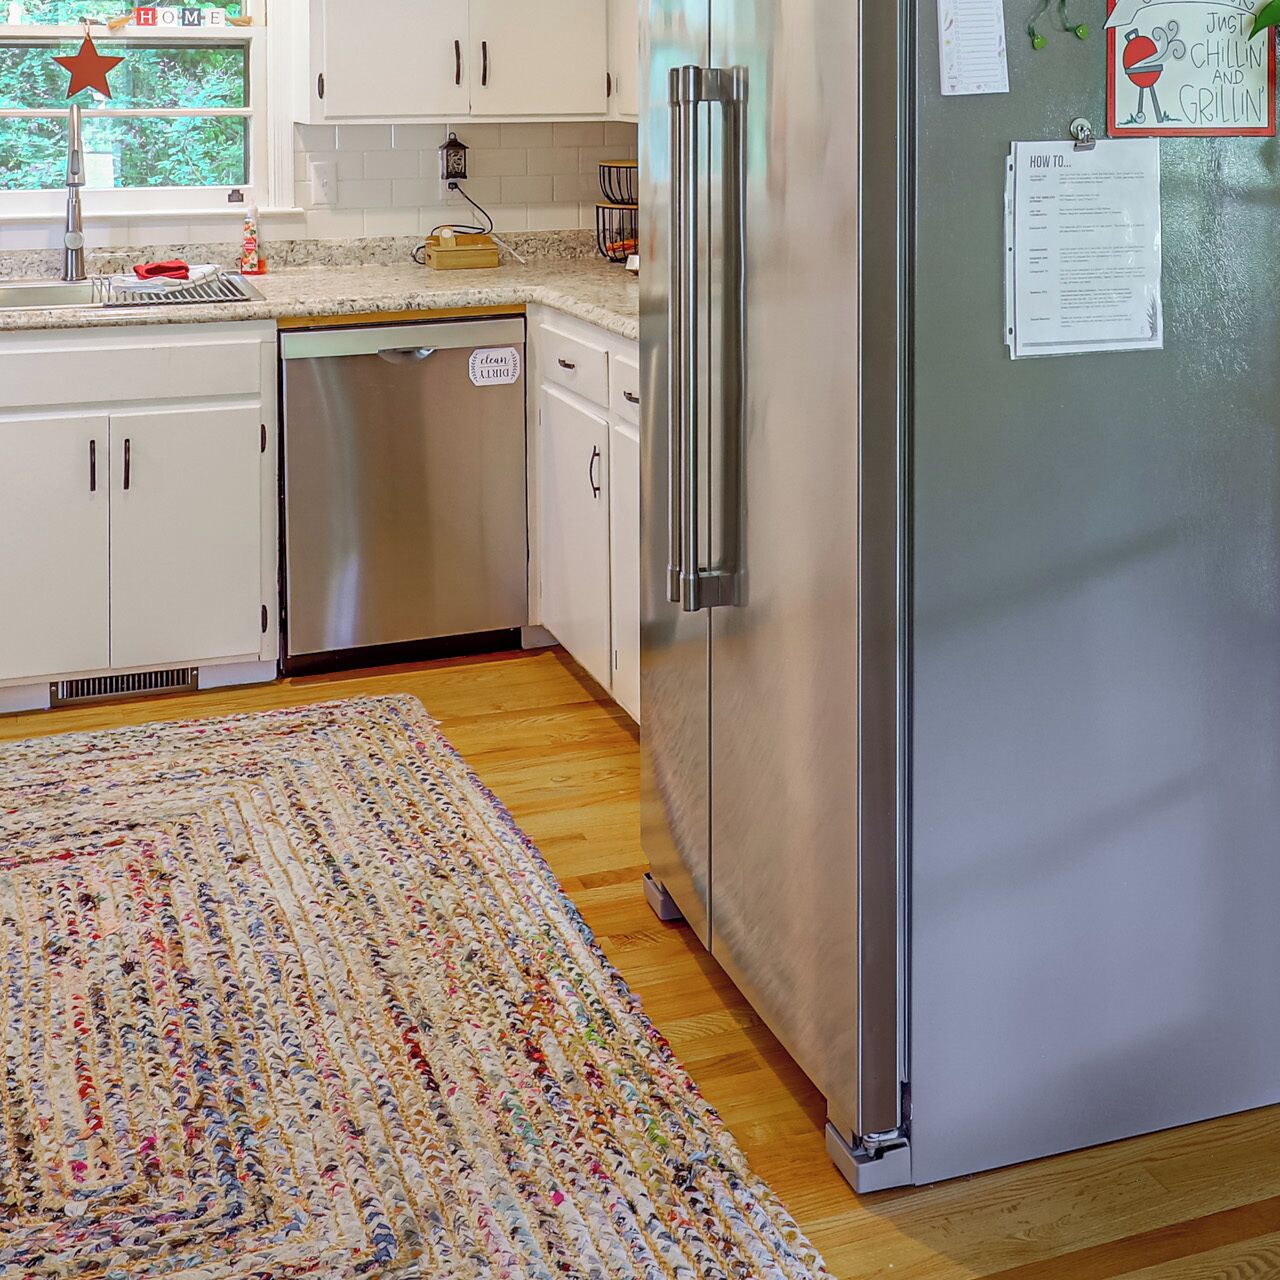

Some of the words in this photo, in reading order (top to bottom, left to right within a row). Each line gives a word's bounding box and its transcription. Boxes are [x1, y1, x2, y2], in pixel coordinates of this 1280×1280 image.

[140, 9, 220, 25] HOME
[1212, 69, 1245, 85] AND
[1030, 155, 1051, 169] HOW
[1053, 154, 1072, 168] TO...
[480, 354, 511, 365] clean
[480, 368, 509, 379] DIRTY
